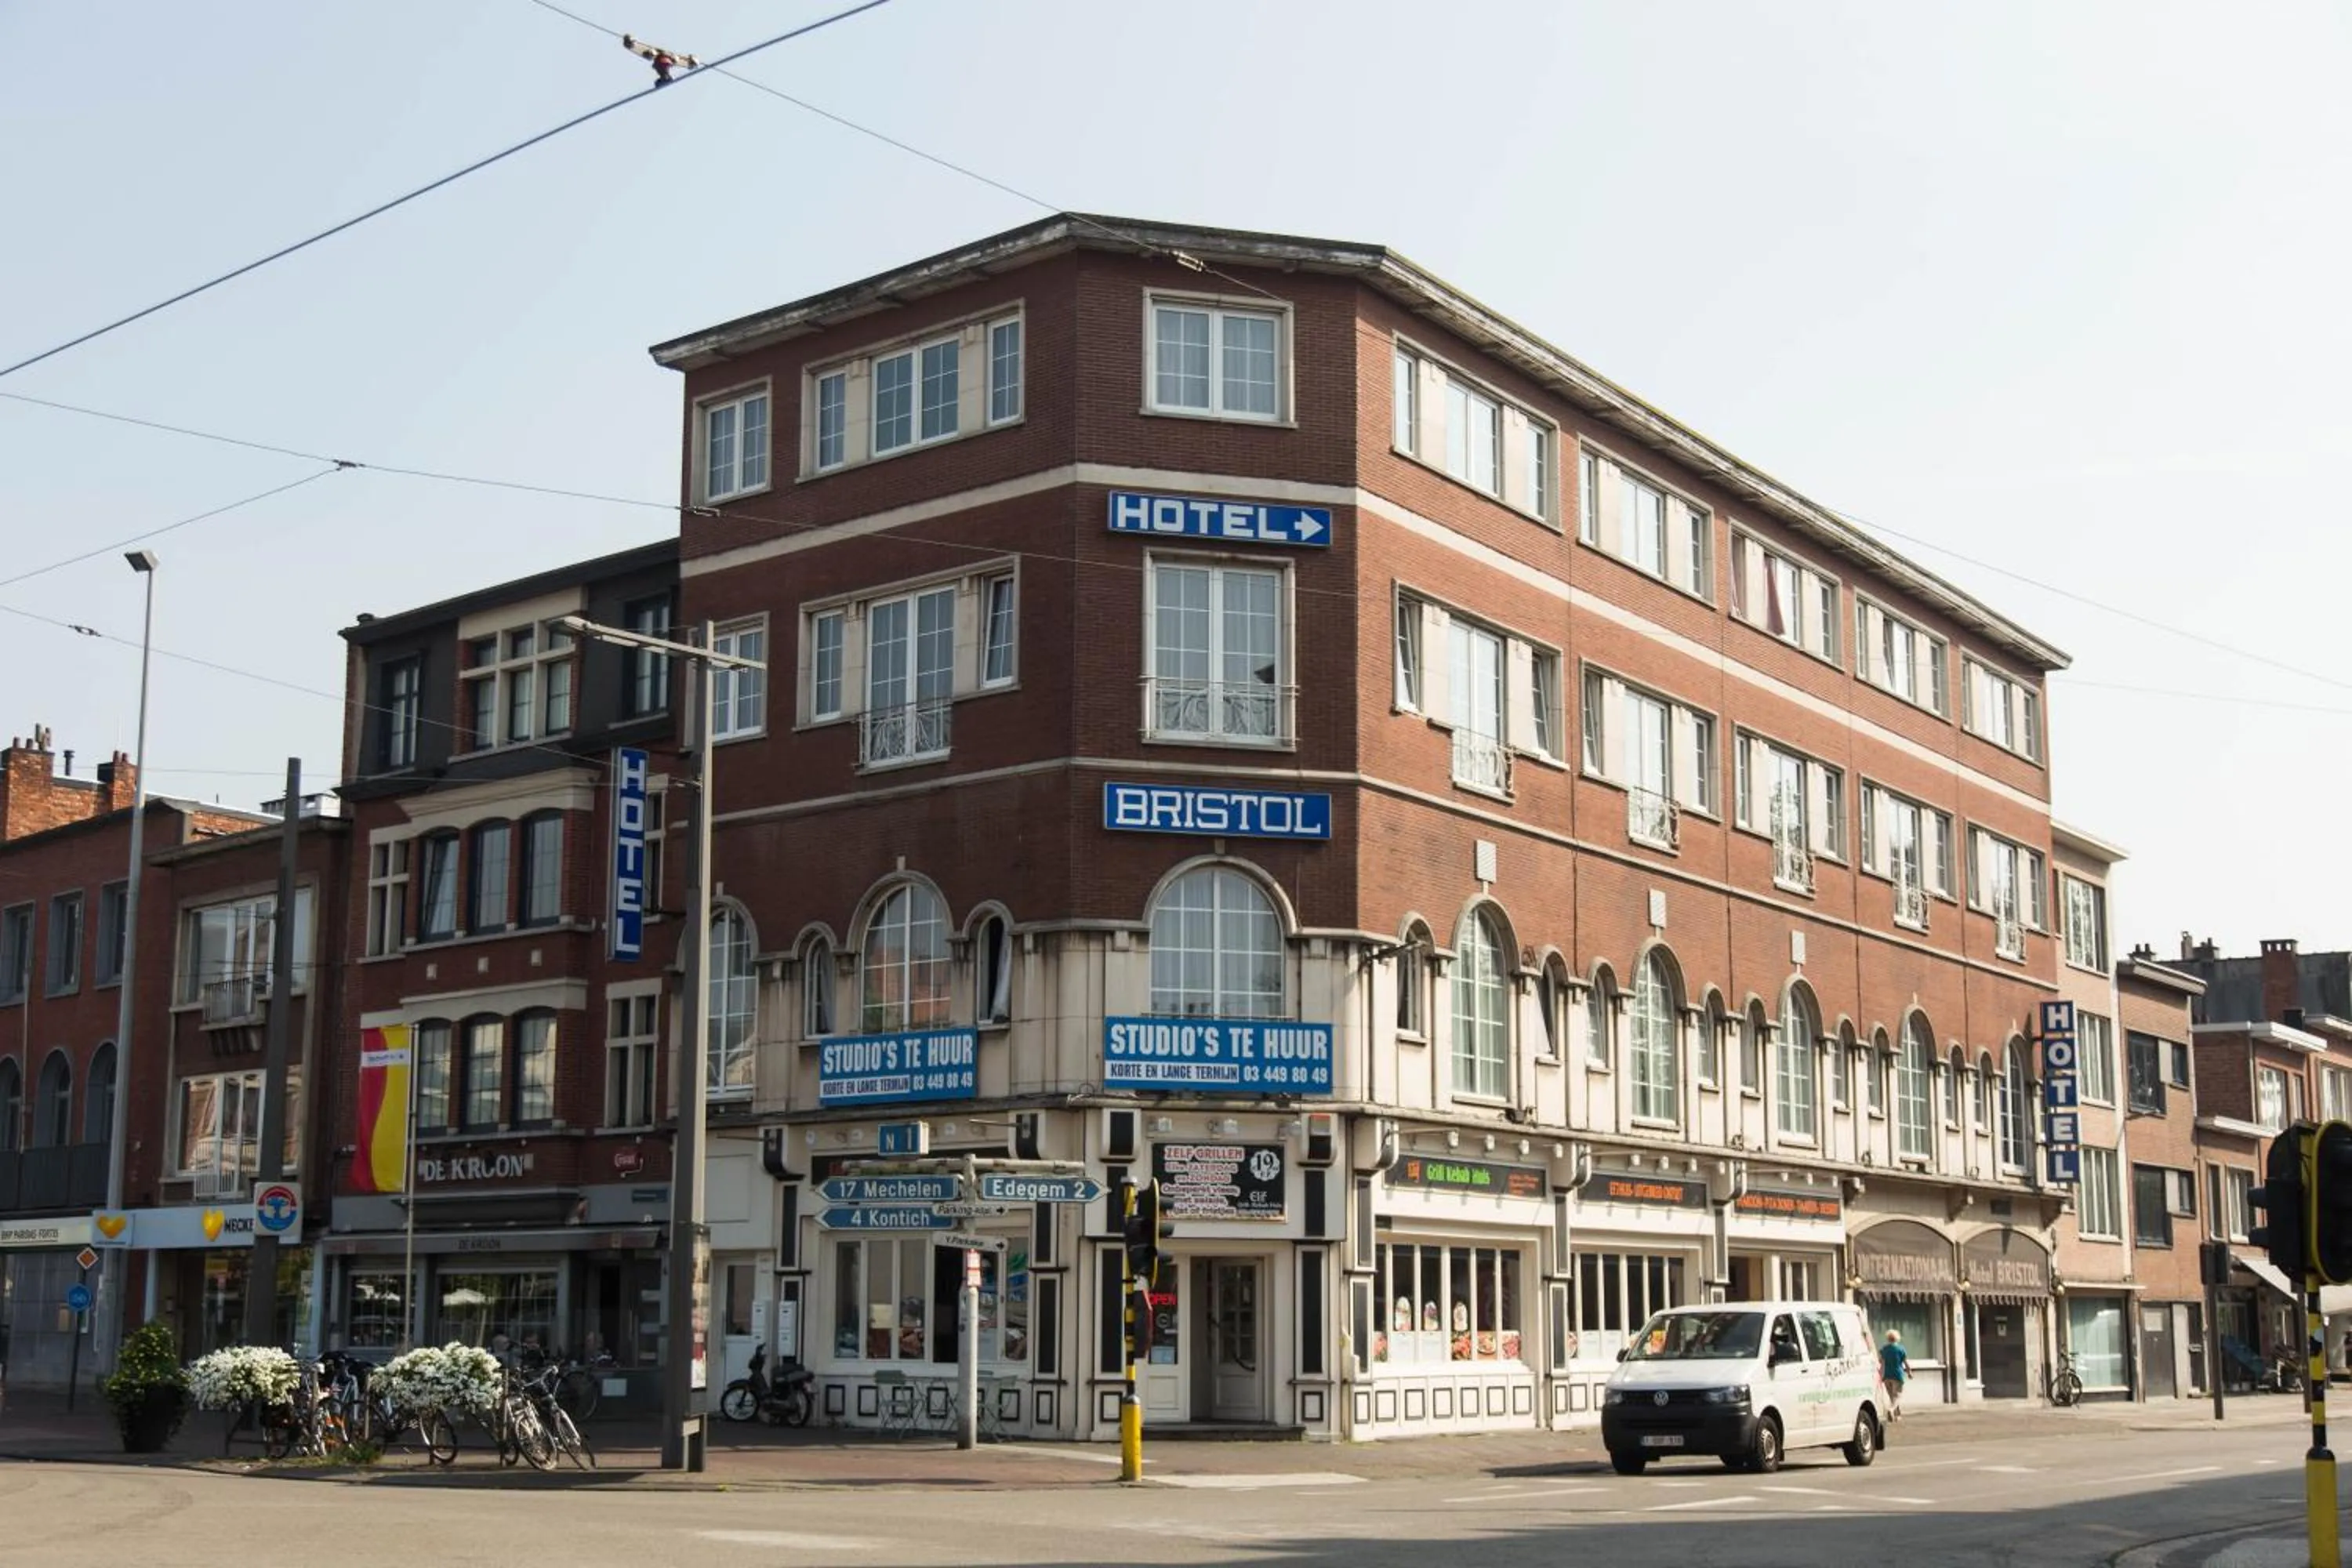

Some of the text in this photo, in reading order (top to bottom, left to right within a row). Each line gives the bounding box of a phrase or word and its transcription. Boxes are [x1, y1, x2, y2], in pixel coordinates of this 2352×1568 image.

[1116, 495, 1287, 540] HOTEL
[1116, 789, 1321, 833] BRISTOL
[616, 756, 645, 953] HOTEL
[1110, 1023, 1327, 1060] STUDIO'S TE HUUR
[824, 1035, 973, 1073] STUDIO'S TE HUUR
[823, 1080, 844, 1095] KORTE
[846, 1080, 855, 1094] EN
[913, 1075, 924, 1091] 03
[927, 1073, 944, 1090] 449
[946, 1073, 958, 1088] 80
[960, 1072, 973, 1087] 49
[1110, 1063, 1328, 1083] KORTE EN LANGE TERMIJN 03 449 80 49
[2046, 1004, 2074, 1178] HOTEL
[886, 1127, 913, 1149] N 1
[1165, 1146, 1243, 1160] ZELF GRILLEN
[1257, 1154, 1273, 1171] 19
[424, 1160, 445, 1181] DE
[840, 1180, 942, 1198] 17 Mechelen
[993, 1180, 1086, 1200] Edegem 2
[224, 1218, 254, 1233] NECKE
[851, 1209, 930, 1225] 4 Kontich
[1857, 1254, 1953, 1282] INTERNATIONAAL
[1998, 1261, 2042, 1287] BRISTOL
[1149, 1293, 1177, 1305] OPEN
